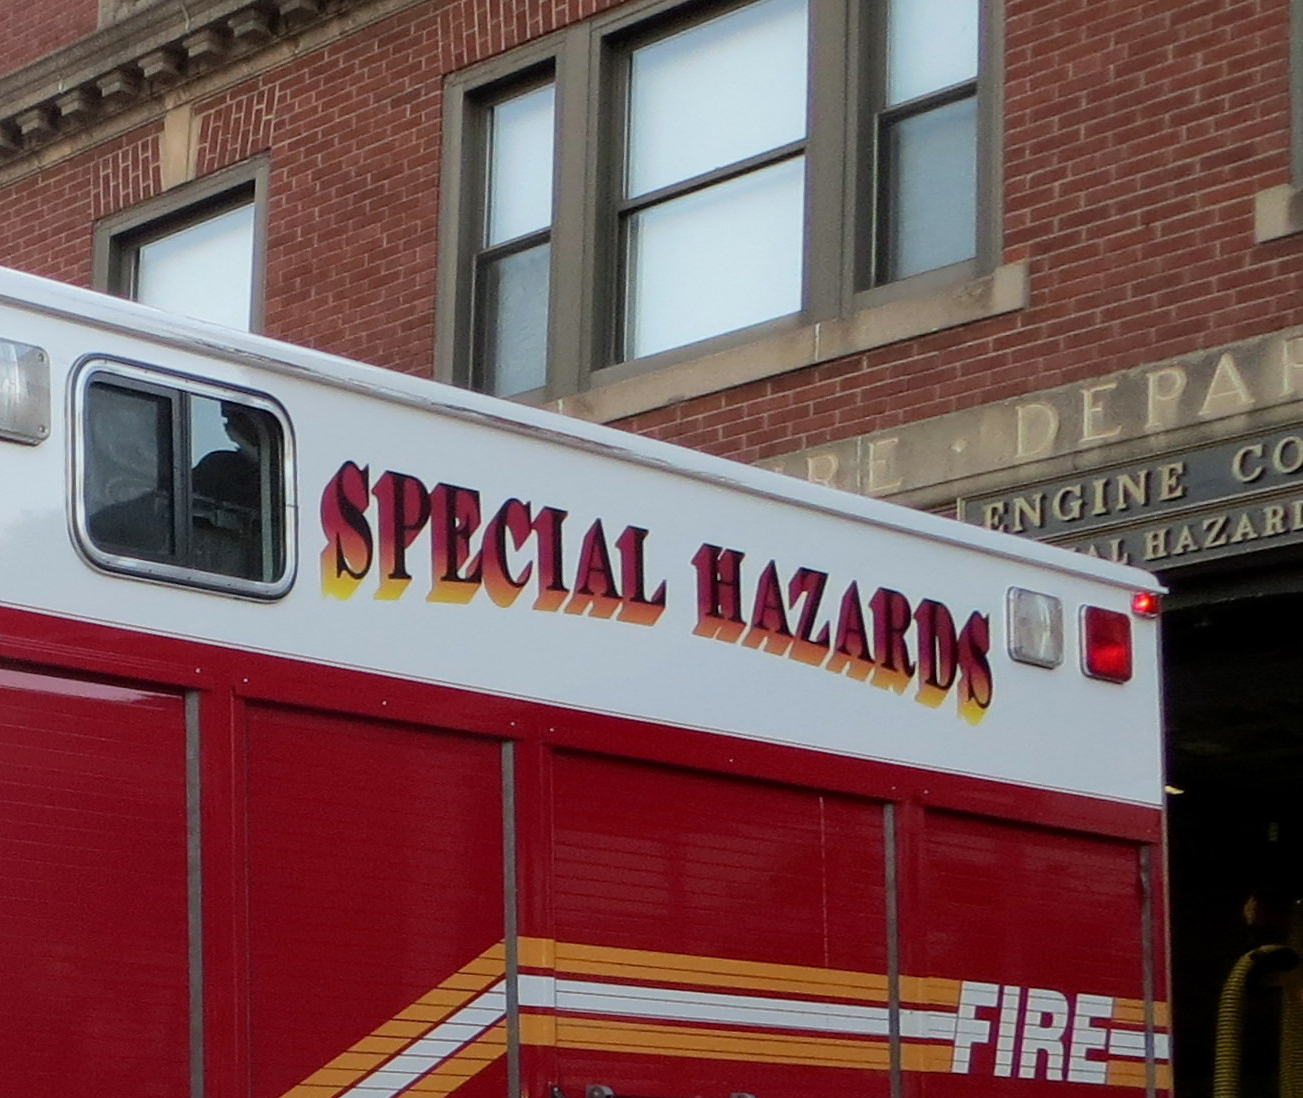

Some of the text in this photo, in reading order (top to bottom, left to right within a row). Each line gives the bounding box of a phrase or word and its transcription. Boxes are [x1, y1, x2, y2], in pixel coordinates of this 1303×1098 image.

[981, 461, 1188, 532] ENGINE
[320, 461, 994, 726] SPECIAL HAZARDS
[951, 980, 1114, 1085] FIRE
